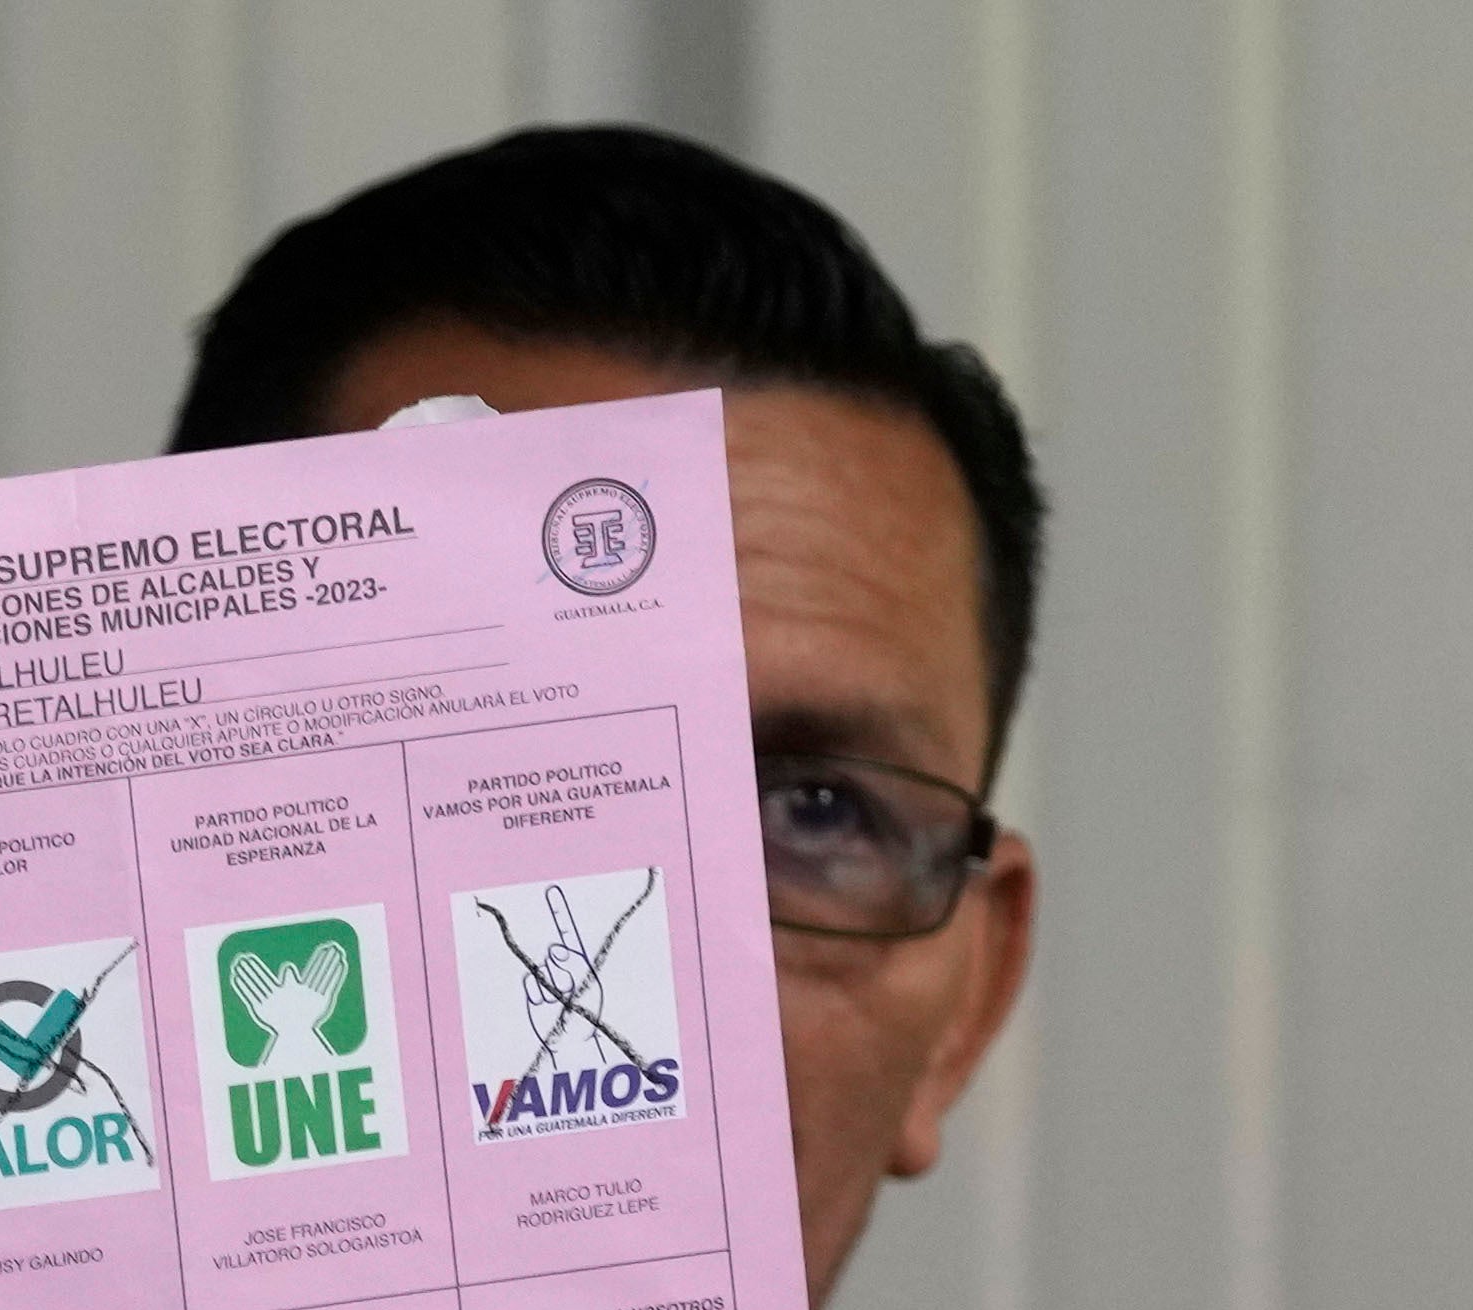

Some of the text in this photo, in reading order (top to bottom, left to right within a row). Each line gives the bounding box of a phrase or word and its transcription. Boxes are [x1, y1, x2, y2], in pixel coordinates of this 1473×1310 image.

[190, 506, 415, 561] ELECTORAL
[91, 580, 131, 607] DE
[140, 559, 295, 601] ALCALDES
[301, 556, 320, 579] Y
[100, 587, 297, 634] MUNICIPALES
[305, 577, 387, 606] -2023-
[30, 768, 53, 785] LA
[151, 752, 185, 769] DEL
[188, 745, 236, 764] VOTO
[239, 741, 274, 758] SEA
[467, 761, 623, 794] PARTIDO POLITICO
[194, 796, 349, 830] PARTIDO POLITICO
[422, 775, 671, 820] VAMOS POR UNA GUATEMALA
[170, 813, 378, 853] UNIDAD NACIONAL DE LA
[502, 805, 596, 830] DIFERENTE
[226, 840, 327, 866] ESPERANZA
[472, 1058, 679, 1128] VAMOS
[228, 1066, 382, 1167] UNE
[529, 1178, 643, 1207] MARCO TULIO
[243, 1213, 386, 1247] JOSE FRANCISCO
[516, 1196, 660, 1228] RODRIGUEZ LEPE
[28, 1247, 104, 1271] GALINDO
